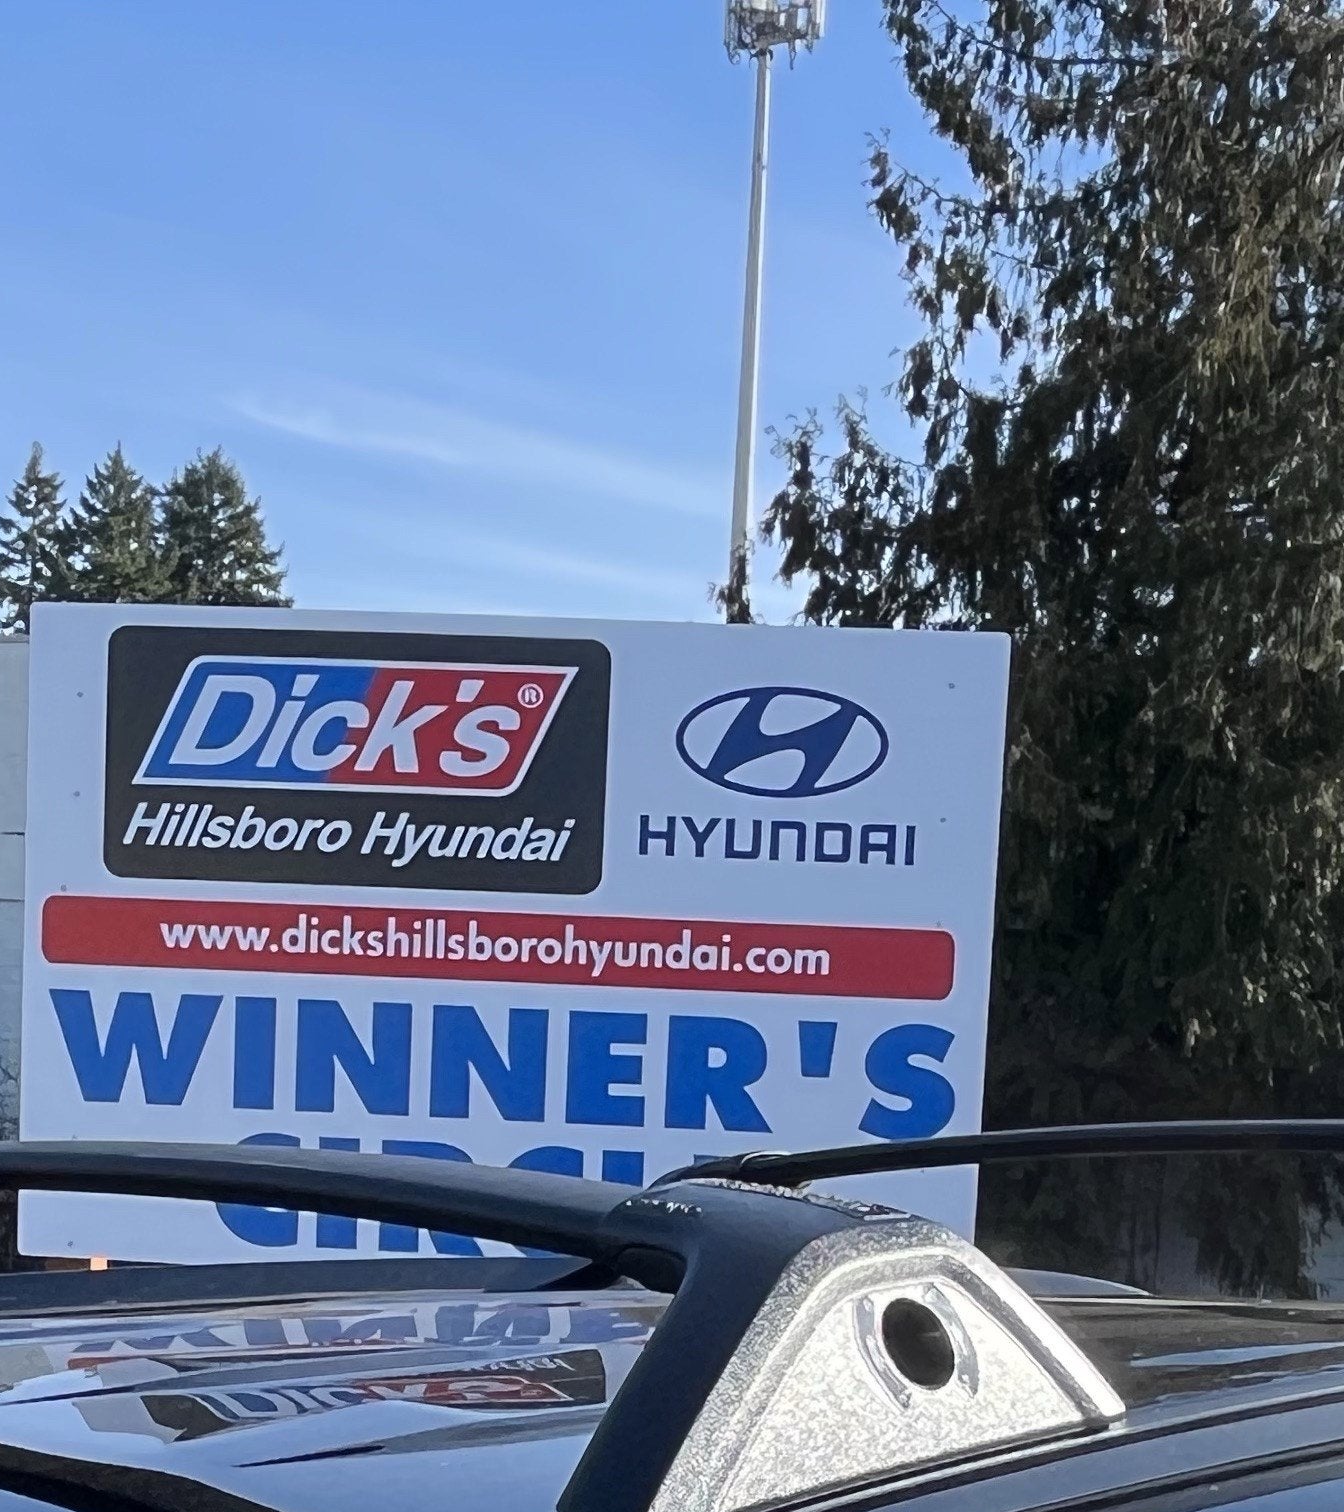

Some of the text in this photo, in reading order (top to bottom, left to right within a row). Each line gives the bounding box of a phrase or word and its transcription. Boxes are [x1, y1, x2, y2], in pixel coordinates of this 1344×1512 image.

[122, 801, 576, 868] Hillsboro Hyundai
[638, 814, 917, 866] HYUNDAI
[159, 913, 830, 978] www.dickshillsborohyundai.com
[49, 988, 956, 1141] WINNER'S
